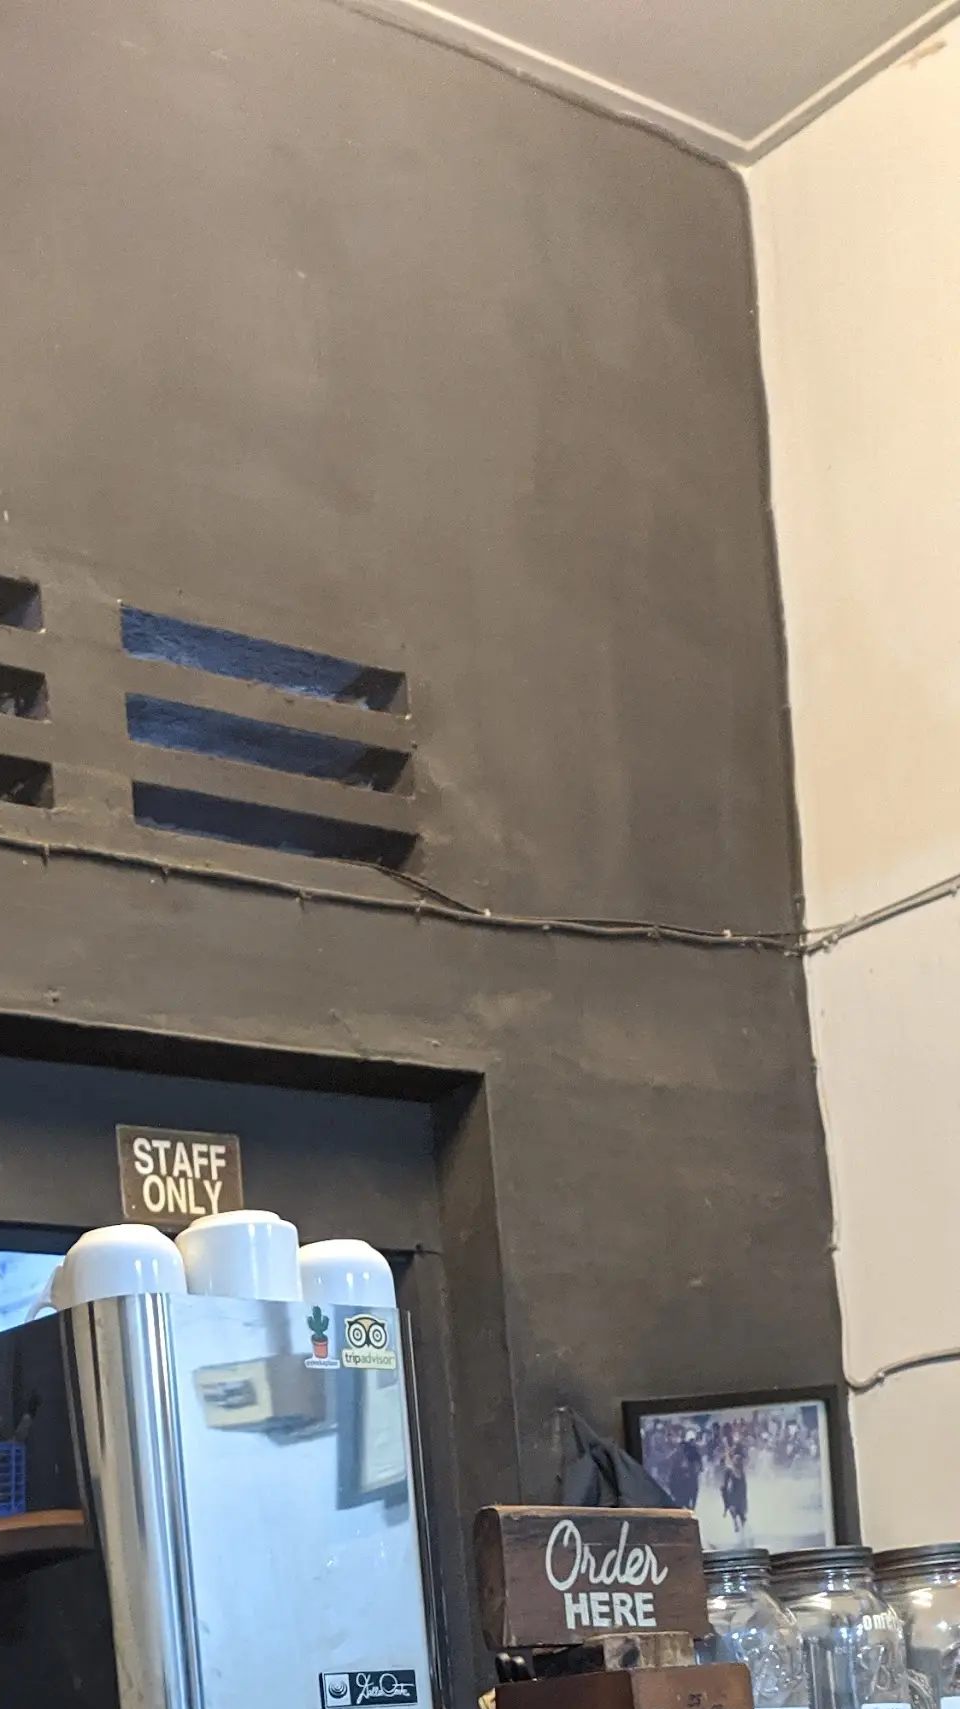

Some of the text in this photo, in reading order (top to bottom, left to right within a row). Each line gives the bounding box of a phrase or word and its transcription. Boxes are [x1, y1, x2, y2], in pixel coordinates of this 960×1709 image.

[132, 1137, 226, 1180] STAFF
[142, 1174, 223, 1215] ONLY
[344, 1352, 395, 1365] tripadvisor
[545, 1519, 669, 1592] Order
[563, 1592, 657, 1630] HERE
